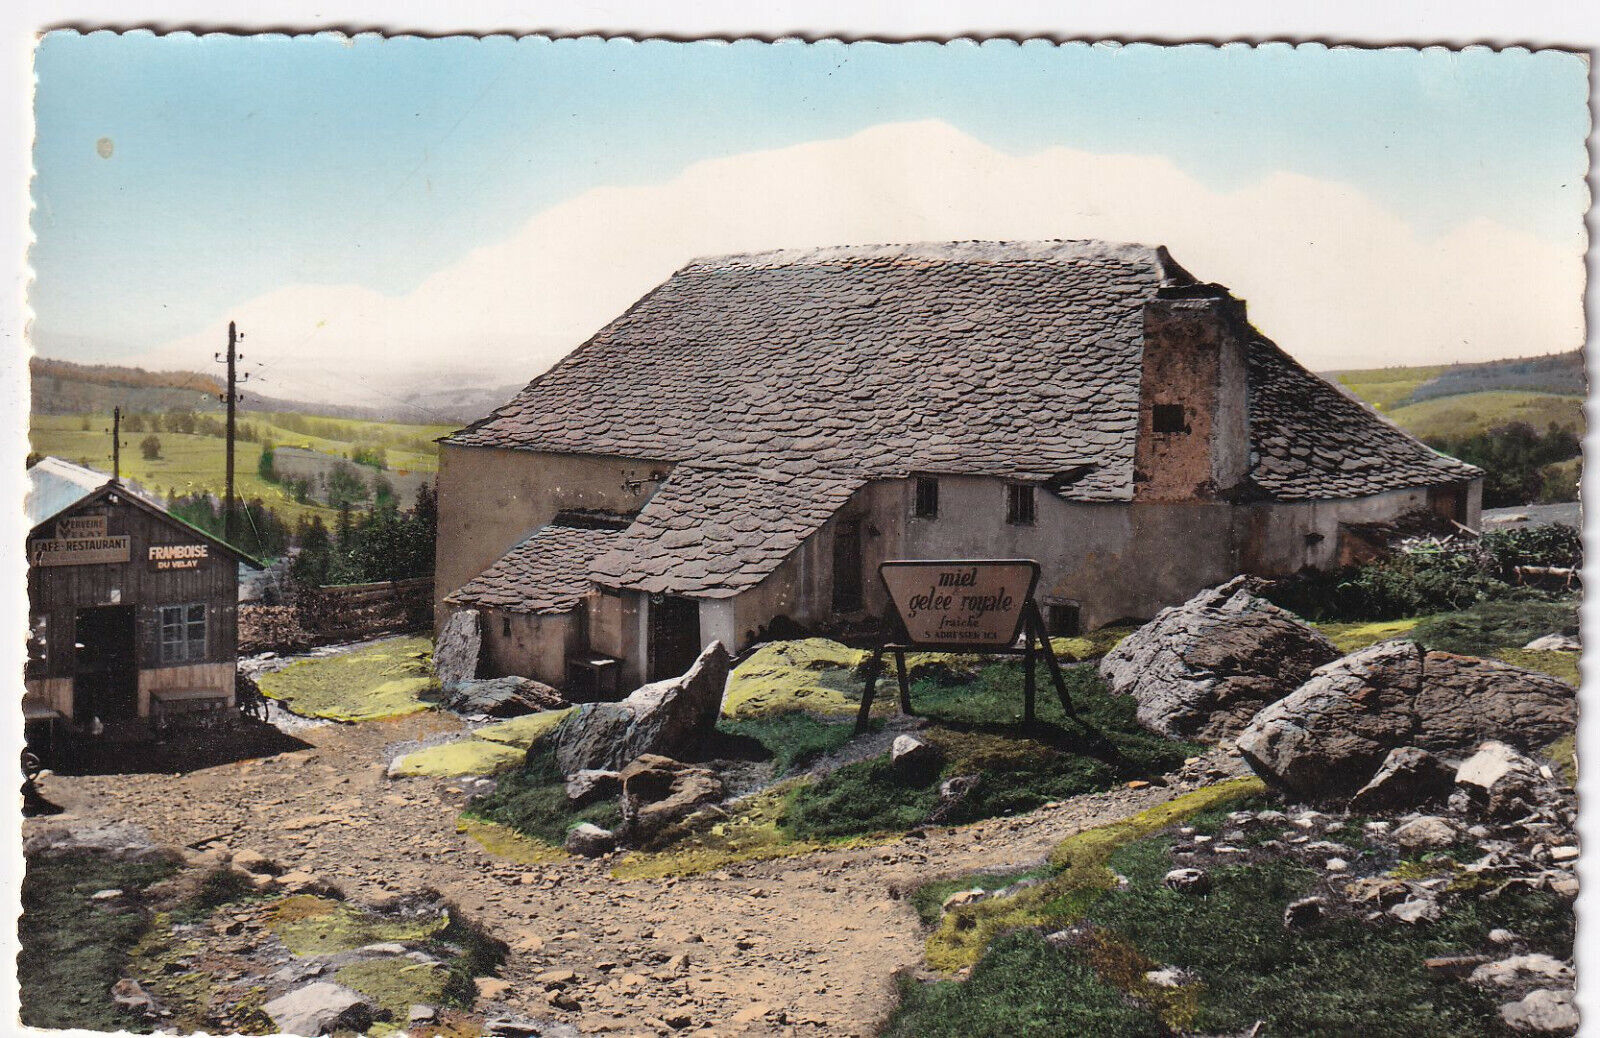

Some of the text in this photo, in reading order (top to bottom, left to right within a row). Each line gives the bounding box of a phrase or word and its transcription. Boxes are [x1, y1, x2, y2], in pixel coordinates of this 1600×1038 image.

[60, 519, 103, 529] VERVEINE
[149, 545, 208, 560] FRAMBOISE
[158, 560, 198, 569] DU VELAY
[938, 567, 977, 587] miel
[908, 586, 1012, 618] gelée royale
[984, 631, 997, 640] ICI
